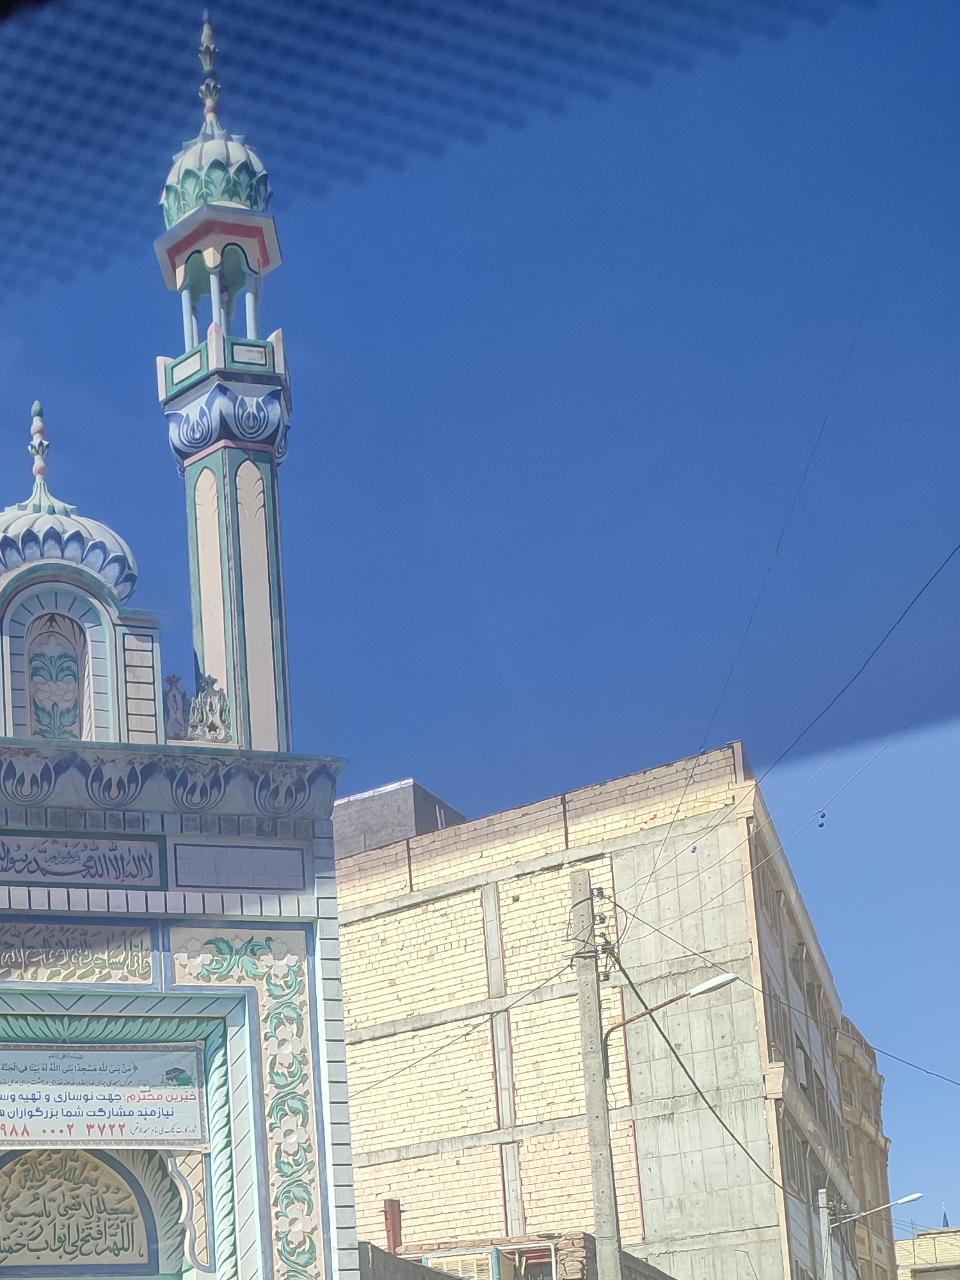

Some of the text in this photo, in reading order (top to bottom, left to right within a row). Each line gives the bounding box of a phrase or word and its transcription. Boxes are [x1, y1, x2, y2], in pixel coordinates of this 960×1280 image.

[18, 1090, 42, 1104] تهیه
[44, 1092, 51, 1103] و
[53, 1090, 94, 1104] نوسازی
[95, 1091, 122, 1103] جهت
[7, 1106, 59, 1120] بزرگواران
[61, 1105, 84, 1118] شما
[85, 1105, 134, 1119] مشارکت
[137, 1106, 175, 1120] نیازمند
